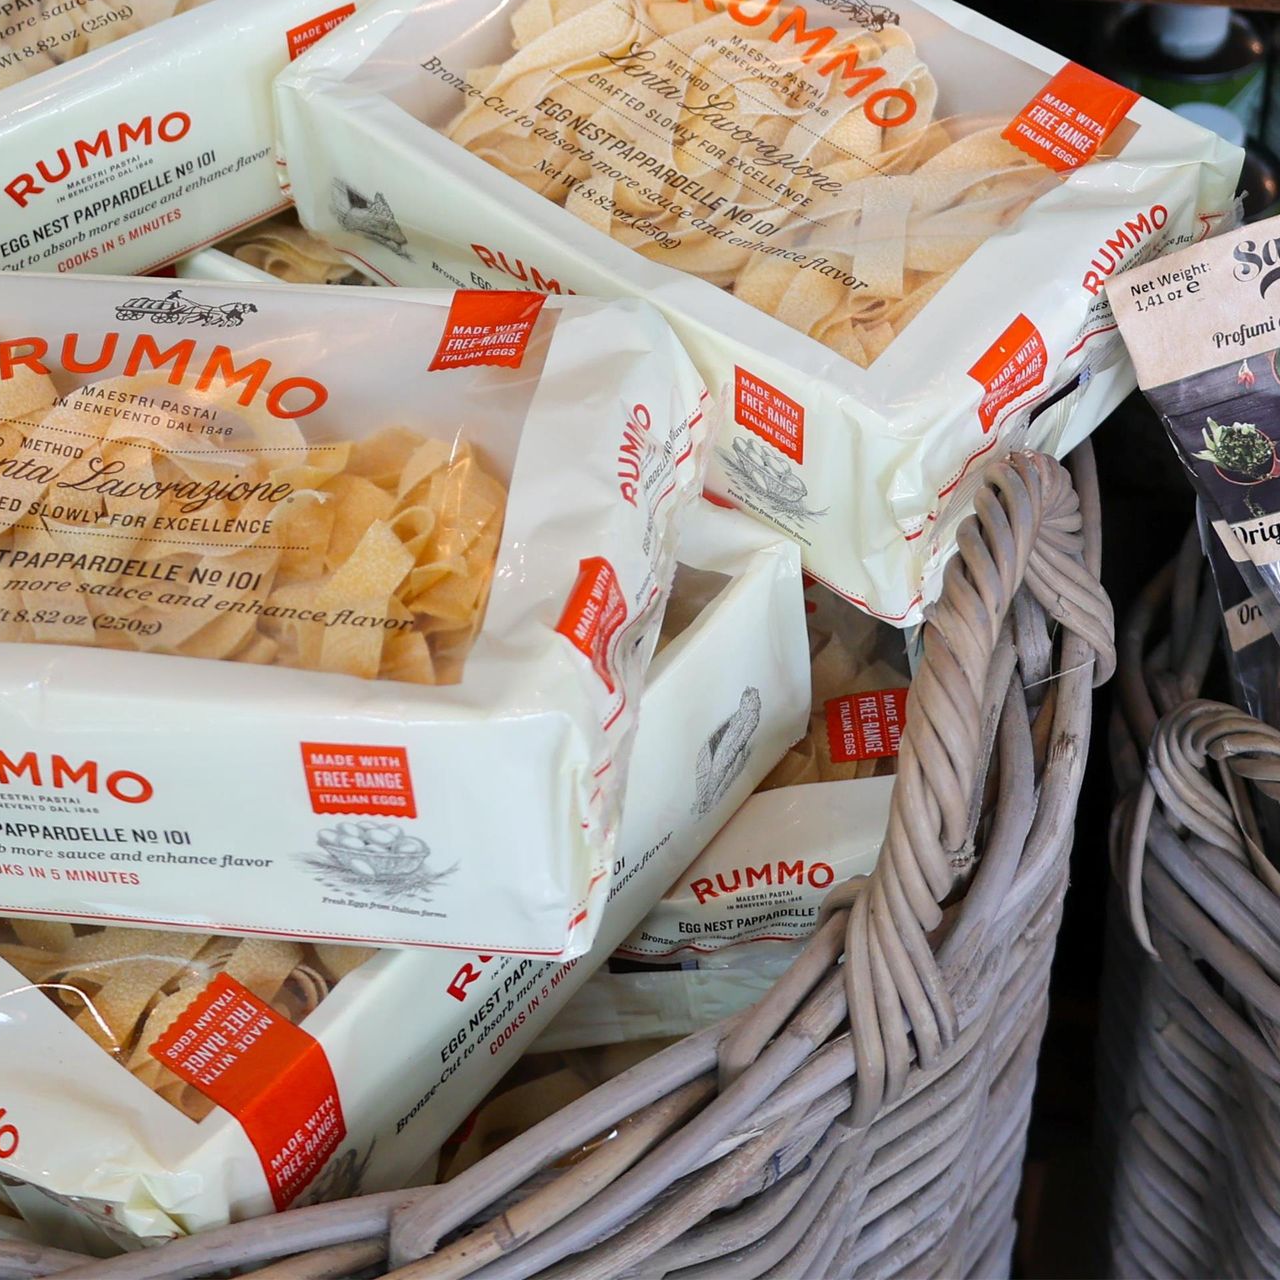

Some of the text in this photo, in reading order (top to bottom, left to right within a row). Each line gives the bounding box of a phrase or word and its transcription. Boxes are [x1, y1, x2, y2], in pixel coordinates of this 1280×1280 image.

[23, 36, 59, 59] 8.82
[61, 30, 81, 41] oz
[81, 6, 134, 34] (250g)
[599, 41, 843, 192] Lenta Lavorazione
[1027, 105, 1096, 154] FREE-RANGE
[1042, 93, 1105, 137] MADE WITH
[4, 111, 191, 208] RUMMO
[535, 97, 573, 123] EGG
[566, 115, 616, 153] NEST
[610, 135, 728, 211] PAPPARDELLE
[1016, 122, 1078, 166] ITALIAN EGGS
[0, 234, 30, 258] EGG
[33, 215, 70, 241] NEST
[74, 170, 172, 224] PAPPARDELLE
[1082, 204, 1169, 297] RUMMO
[1129, 263, 1212, 297] Net Weight:
[1135, 290, 1184, 312] 1,41 oz
[1212, 318, 1276, 348] Profumi
[81, 386, 217, 421] MAESTRI PASTAI
[741, 377, 799, 420] MADE WITH
[741, 390, 798, 438] FREE-RANGE
[20, 436, 84, 459] METHOD
[741, 410, 797, 451] ITALIAN EGGS
[57, 457, 294, 512] Lavorazione
[29, 501, 106, 527] SLOWLY
[110, 513, 146, 528] FOR
[153, 518, 273, 534] EXCELLENCE
[10, 550, 183, 583] PAPPARDELLE
[226, 571, 262, 591] 101
[3, 577, 72, 593] more
[76, 582, 151, 601] sauce
[158, 593, 213, 609] and
[215, 598, 327, 622] enhance
[325, 610, 415, 631] flavor
[15, 610, 57, 624] 8.82
[67, 614, 87, 626] oz
[91, 614, 163, 636] (250g)
[310, 754, 400, 768] MADE WITH
[313, 771, 403, 789] FREE-RANGE
[319, 794, 406, 806] ITALIAN EGGS
[11, 846, 53, 858] more
[57, 850, 105, 860] sauce
[110, 851, 142, 862] and
[146, 853, 217, 865] enhance
[219, 855, 273, 868] flavor
[164, 830, 191, 845] 101
[30, 866, 46, 878] IN
[51, 869, 60, 880] 5
[66, 870, 140, 885] MINUTES
[690, 860, 834, 904] RUMMO
[679, 907, 815, 934] EGG NEST PAPPARDELLE
[167, 988, 236, 1059] ITALIAN EGGS
[181, 1000, 258, 1074] FREE-RANGE
[201, 1016, 273, 1085] MADE WITH
